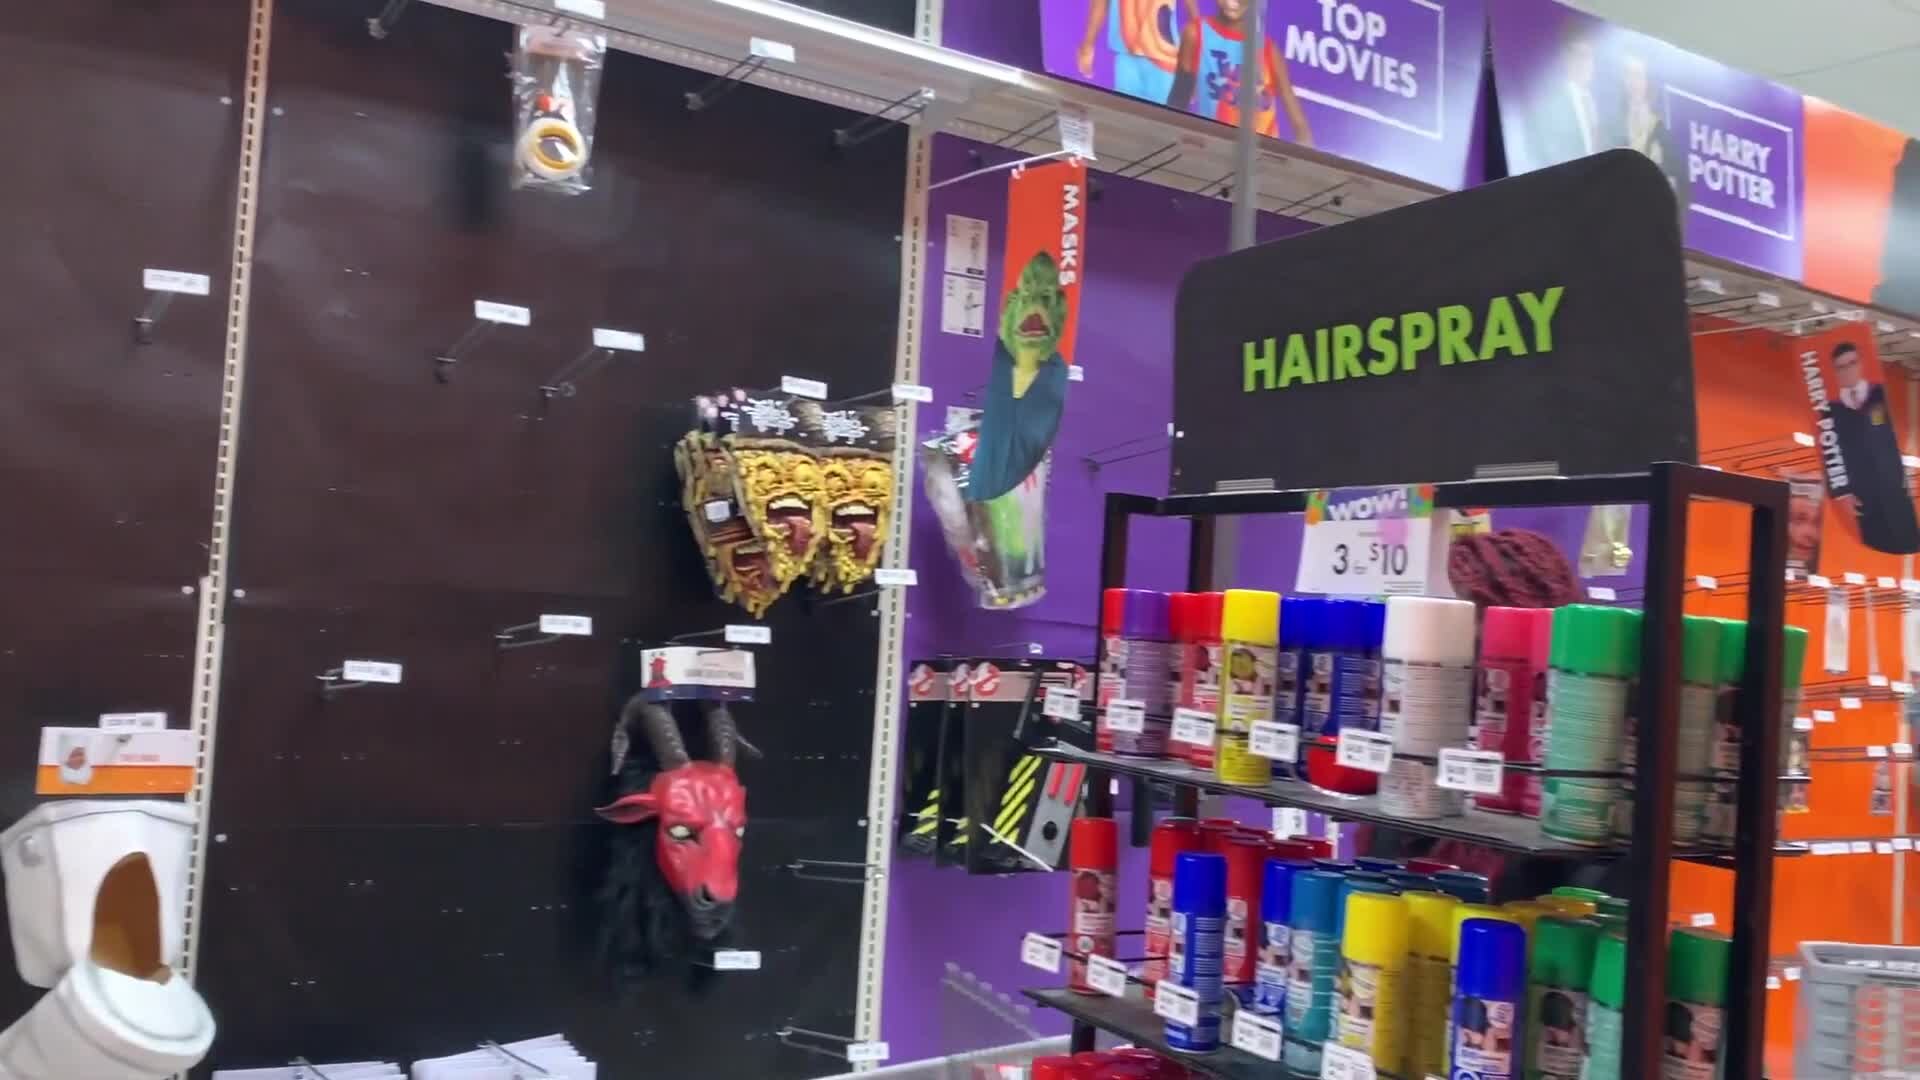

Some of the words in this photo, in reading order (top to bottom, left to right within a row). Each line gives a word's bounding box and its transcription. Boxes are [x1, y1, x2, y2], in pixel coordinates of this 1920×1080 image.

[1317, 0, 1387, 46] TOP
[1285, 24, 1418, 98] MOVIES
[1689, 120, 1772, 173] HARRY
[1687, 153, 1776, 209] POTTER
[1059, 184, 1080, 286] MASKS
[1243, 286, 1565, 392] HAIRSPRAY
[1801, 351, 1831, 411] HARRY
[1816, 417, 1848, 489] POTTER
[1332, 543, 1349, 575] 3
[1368, 542, 1408, 575] $10
